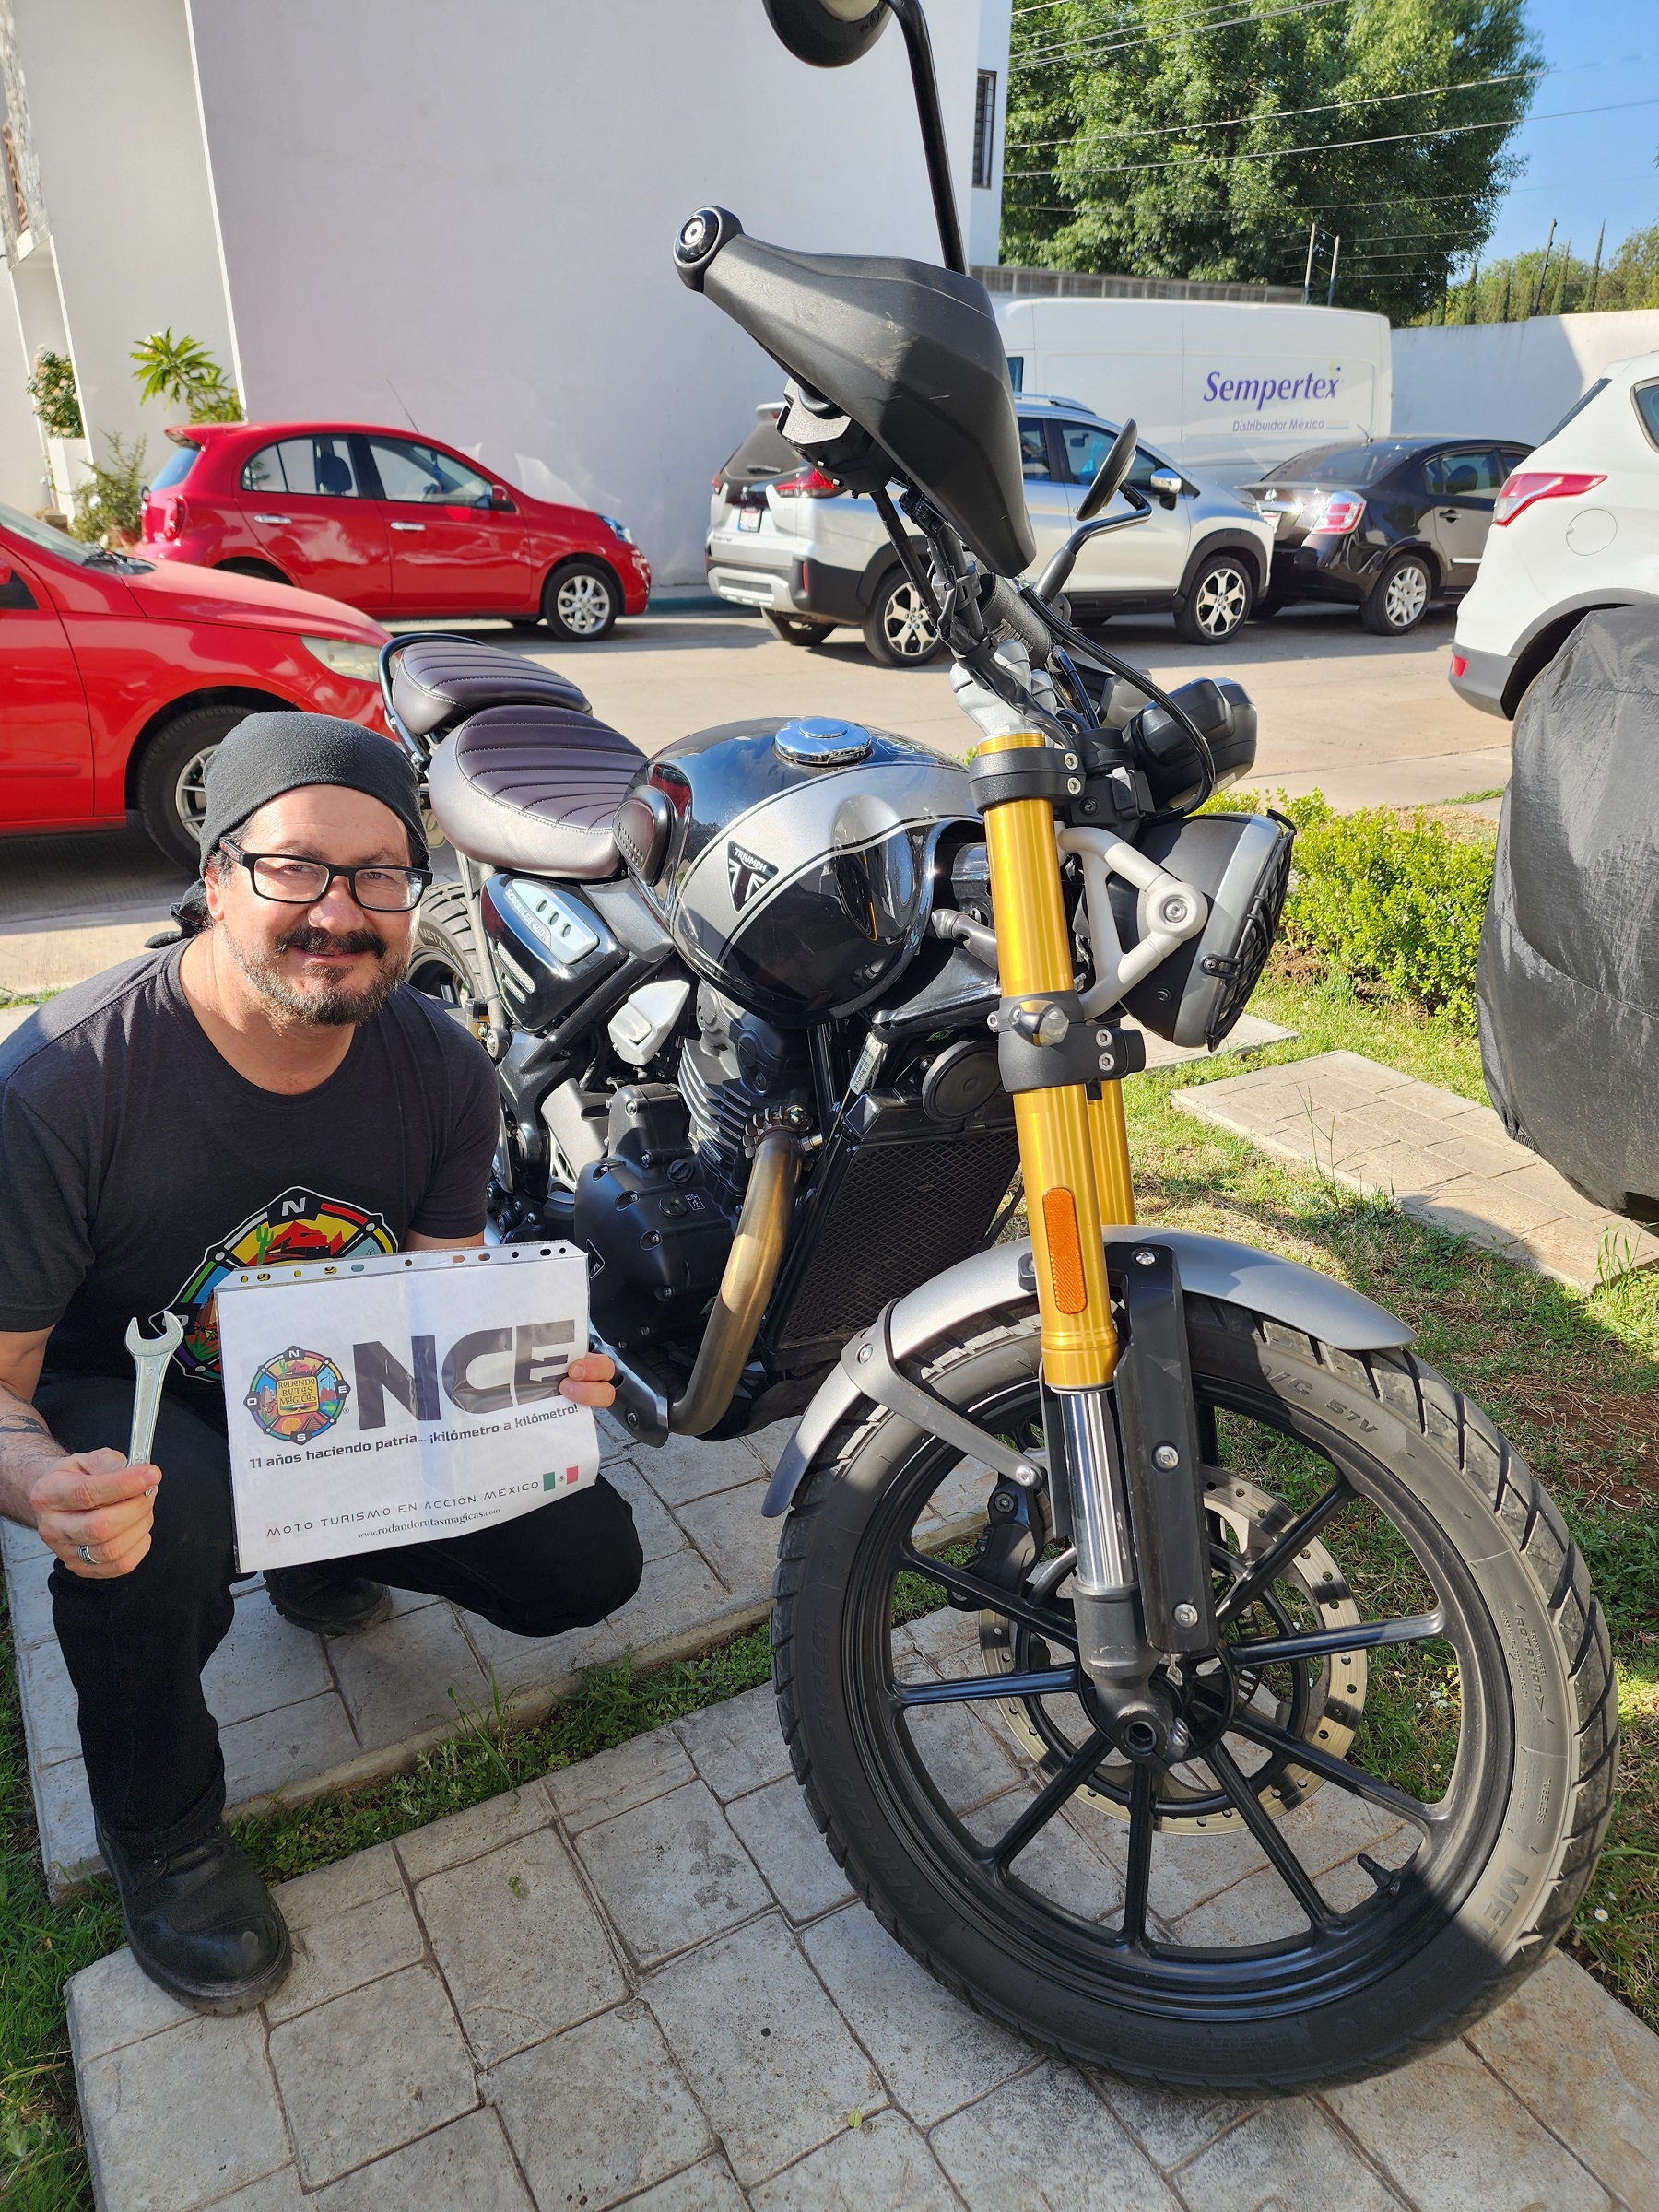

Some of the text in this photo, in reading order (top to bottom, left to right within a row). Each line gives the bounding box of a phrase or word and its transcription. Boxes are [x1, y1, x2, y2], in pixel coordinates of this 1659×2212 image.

[1203, 371, 1339, 411] Sempertex
[1232, 418, 1324, 432] Distribuidor México
[735, 847, 768, 872] TRIUMPH
[281, 1197, 306, 1216] N
[288, 1349, 300, 1359] N
[1325, 1399, 1378, 1433] 57V
[250, 1404, 579, 1468] 11 años haciendo patria... ¡kilómetro a kilómetro!
[266, 1481, 539, 1537] MOTO TURISMO EN ACCIÓN MÉXICO
[358, 1507, 500, 1539] www.rodandorutasmagicas.com
[1536, 1777, 1551, 1825] TUBELESS
